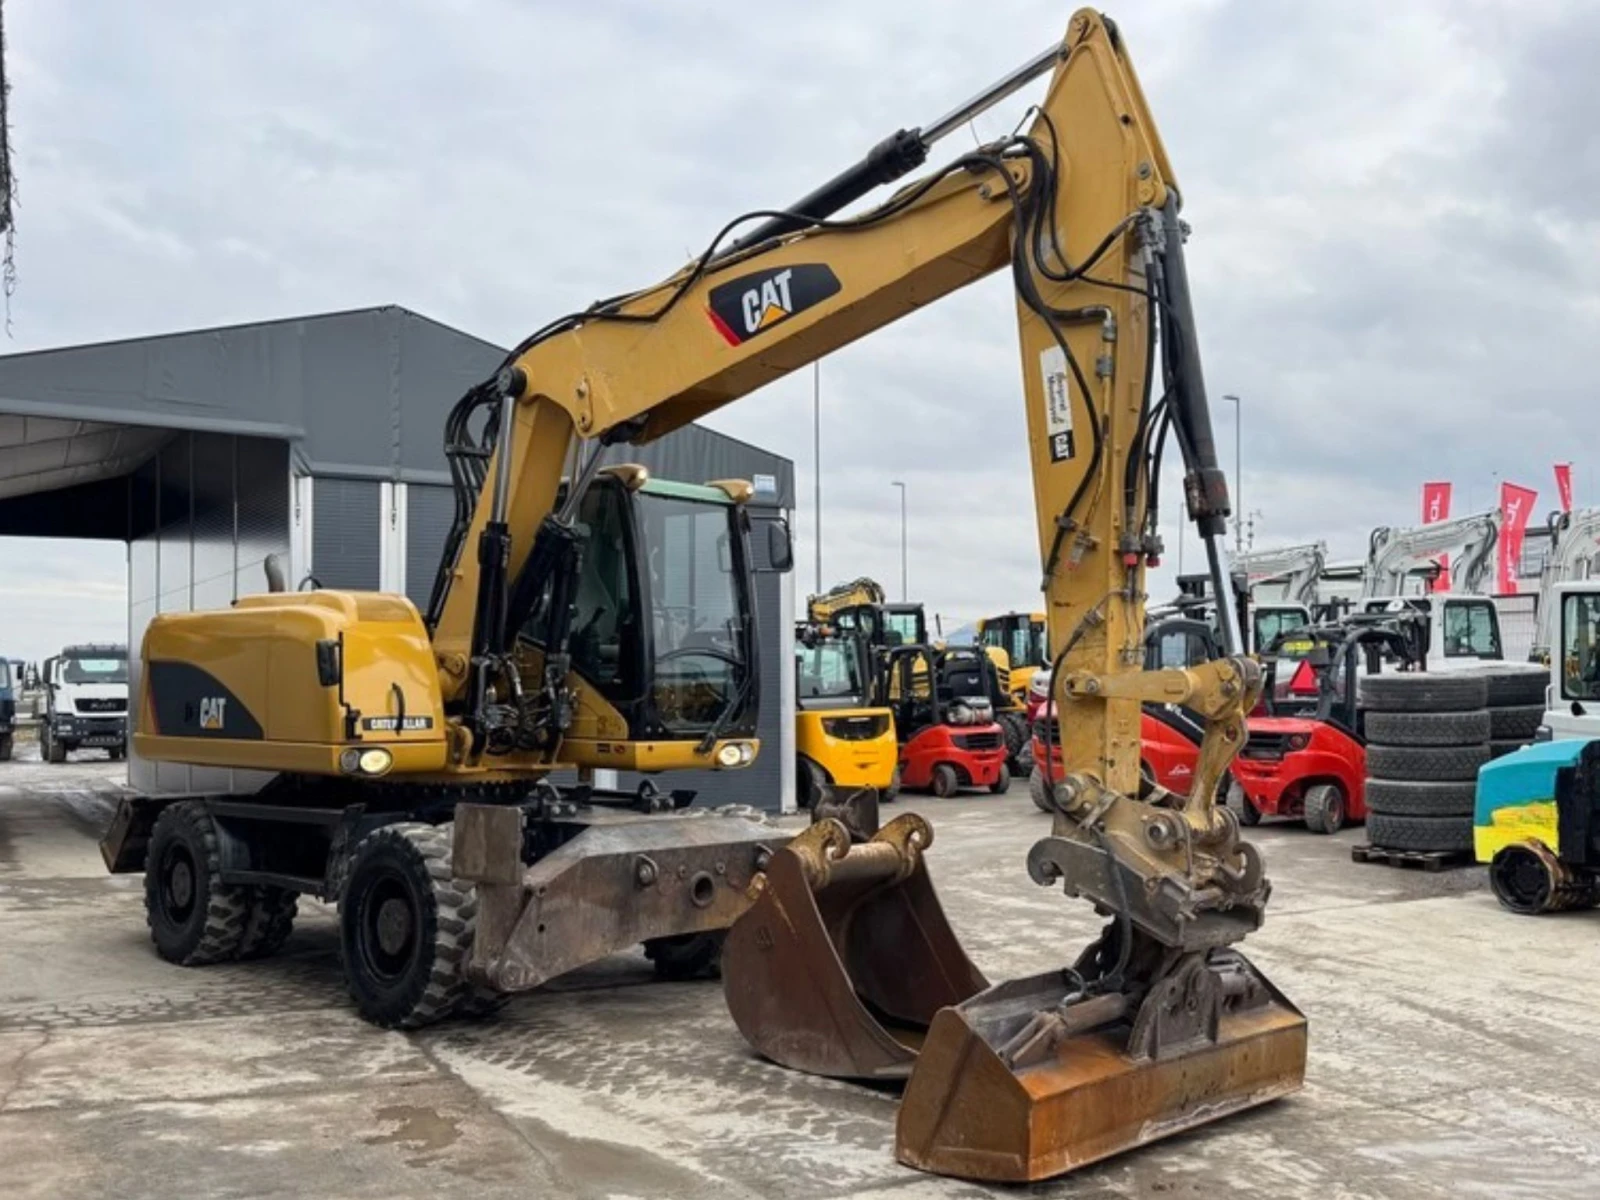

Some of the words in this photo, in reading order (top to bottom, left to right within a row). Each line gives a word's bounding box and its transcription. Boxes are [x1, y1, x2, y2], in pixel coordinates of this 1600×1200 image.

[742, 268, 792, 333] CAT
[1055, 434, 1069, 458] CAT
[200, 697, 226, 729] CAT
